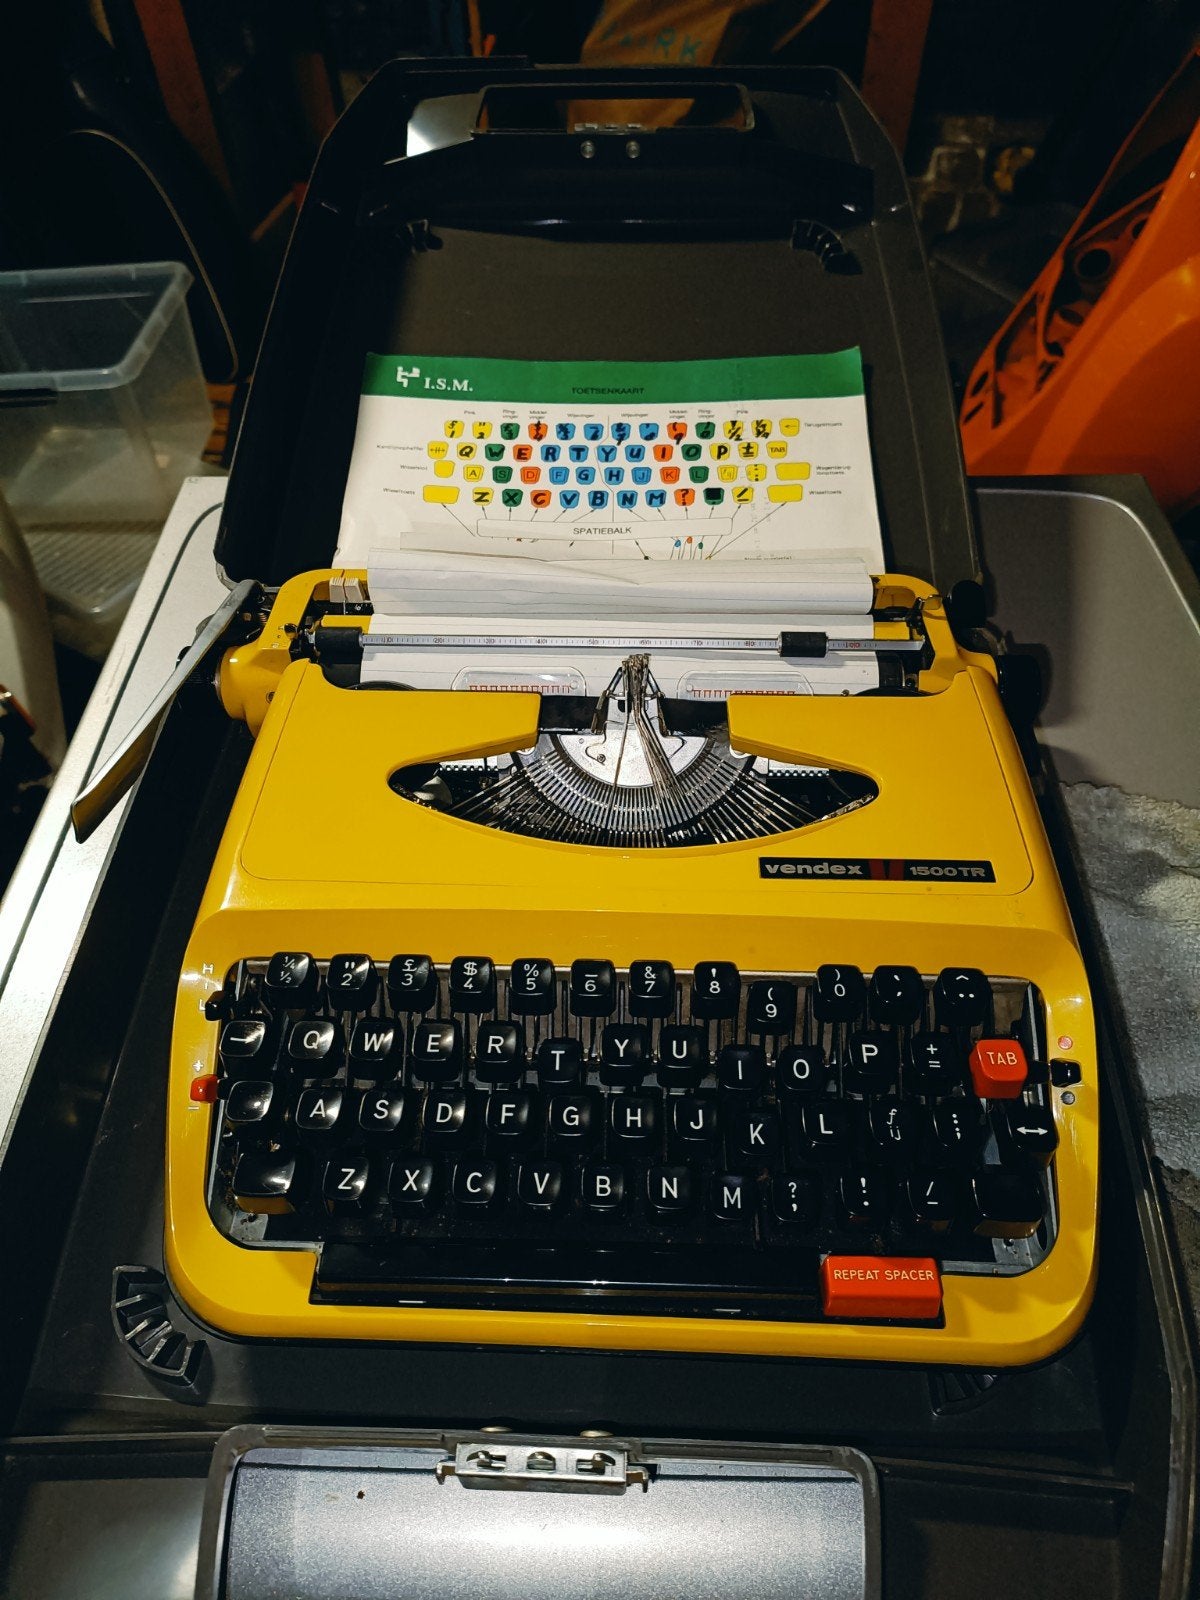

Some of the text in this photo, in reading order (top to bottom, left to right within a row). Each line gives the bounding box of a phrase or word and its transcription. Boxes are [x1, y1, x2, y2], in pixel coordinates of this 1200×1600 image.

[424, 377, 474, 392] I.S.M.
[571, 387, 645, 395] TOETSENKAART
[459, 445, 474, 458] Q
[488, 445, 505, 458] W
[516, 447, 530, 460] E
[544, 446, 557, 462] R
[571, 447, 586, 460] T
[601, 447, 615, 462] Y
[685, 446, 700, 458] O
[716, 445, 729, 460] P
[578, 469, 620, 481] G H
[473, 491, 490, 503] Z
[505, 492, 518, 504] X
[533, 492, 546, 505] C
[562, 493, 578, 506] V
[591, 490, 605, 506] B
[621, 493, 635, 506] N
[648, 492, 665, 505] M
[572, 526, 632, 535] SPATIEBALK
[765, 862, 864, 876] vendex
[463, 961, 478, 976] $
[523, 963, 540, 977] %
[644, 965, 657, 979] &
[341, 973, 353, 986] 2
[401, 974, 413, 986] 3
[463, 977, 474, 990] 4
[525, 977, 537, 991] 5
[584, 979, 597, 992] 6
[644, 980, 656, 993] 7
[709, 980, 721, 994] 8
[765, 1003, 778, 1018] 9
[303, 1030, 320, 1049] Q
[364, 1032, 384, 1052] W
[426, 1034, 442, 1053] E
[487, 1035, 504, 1054] R
[550, 1050, 566, 1070] T
[614, 1038, 630, 1058] Y
[672, 1040, 687, 1059] U
[737, 1060, 743, 1080] I
[792, 1058, 810, 1079] O
[861, 1044, 879, 1064] P
[986, 1051, 1018, 1065] TAB
[309, 1098, 326, 1118] A
[373, 1099, 390, 1120] S
[435, 1103, 453, 1123] D
[500, 1104, 516, 1125] F
[562, 1106, 580, 1126] G
[626, 1107, 642, 1128] H
[689, 1109, 703, 1130] J
[750, 1123, 765, 1145] K
[819, 1113, 834, 1135] L
[337, 1168, 356, 1190] Z
[401, 1169, 420, 1191] X
[466, 1171, 483, 1194] C
[533, 1172, 550, 1195] V
[595, 1175, 612, 1197] B
[661, 1176, 678, 1199] N
[723, 1186, 742, 1209] M
[833, 1269, 935, 1281] REPEAT SPACER
